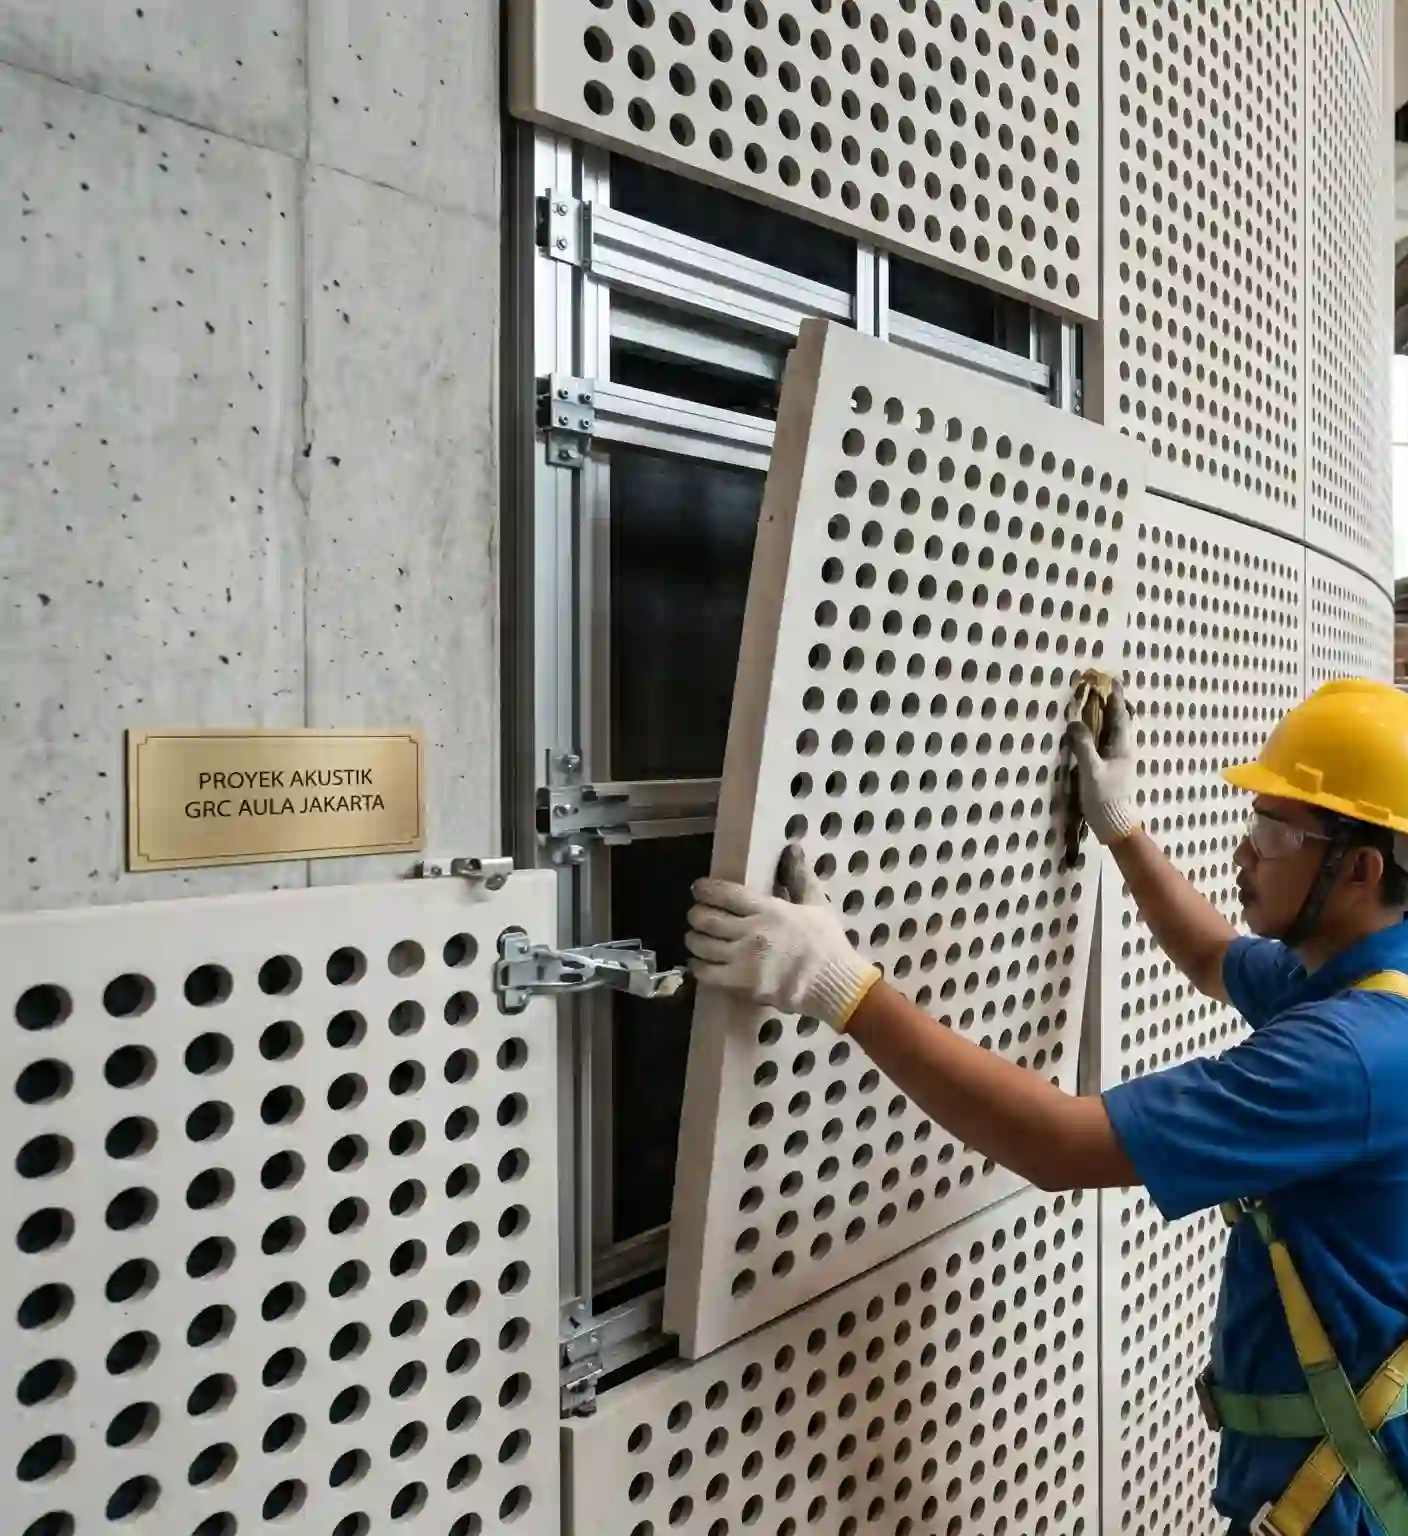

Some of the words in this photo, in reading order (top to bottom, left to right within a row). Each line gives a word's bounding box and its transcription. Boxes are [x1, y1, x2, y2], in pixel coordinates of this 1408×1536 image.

[199, 771, 284, 789] PROYEK
[289, 768, 373, 787] AKUSTIK
[184, 800, 231, 818] GRC
[238, 797, 295, 816] AULA
[299, 794, 385, 813] JAKARTA
